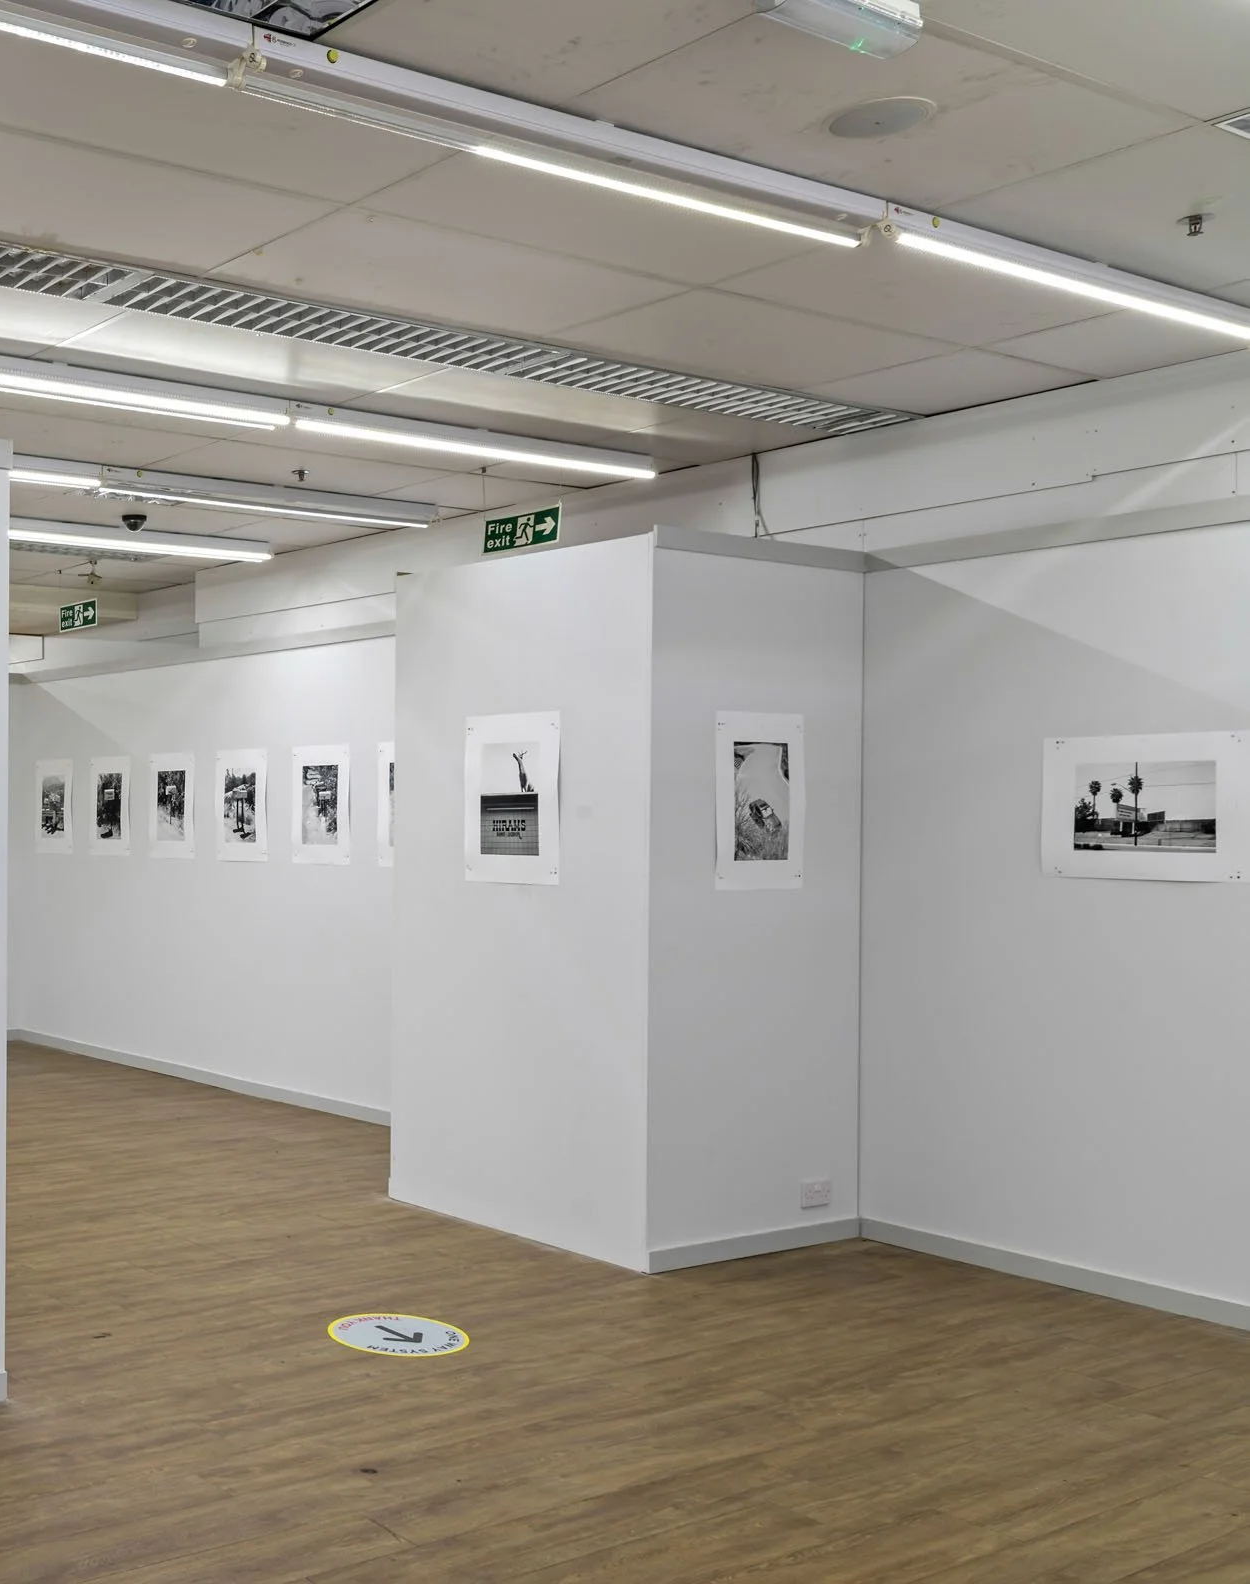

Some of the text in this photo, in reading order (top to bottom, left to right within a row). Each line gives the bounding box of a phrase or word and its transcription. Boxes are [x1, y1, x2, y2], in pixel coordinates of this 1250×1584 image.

[487, 523, 513, 535] Fire
[486, 535, 510, 548] exit
[61, 609, 73, 618] Fire
[61, 618, 73, 628] exit
[366, 1345, 429, 1354] SYSTEM
[432, 1342, 455, 1352] WAY
